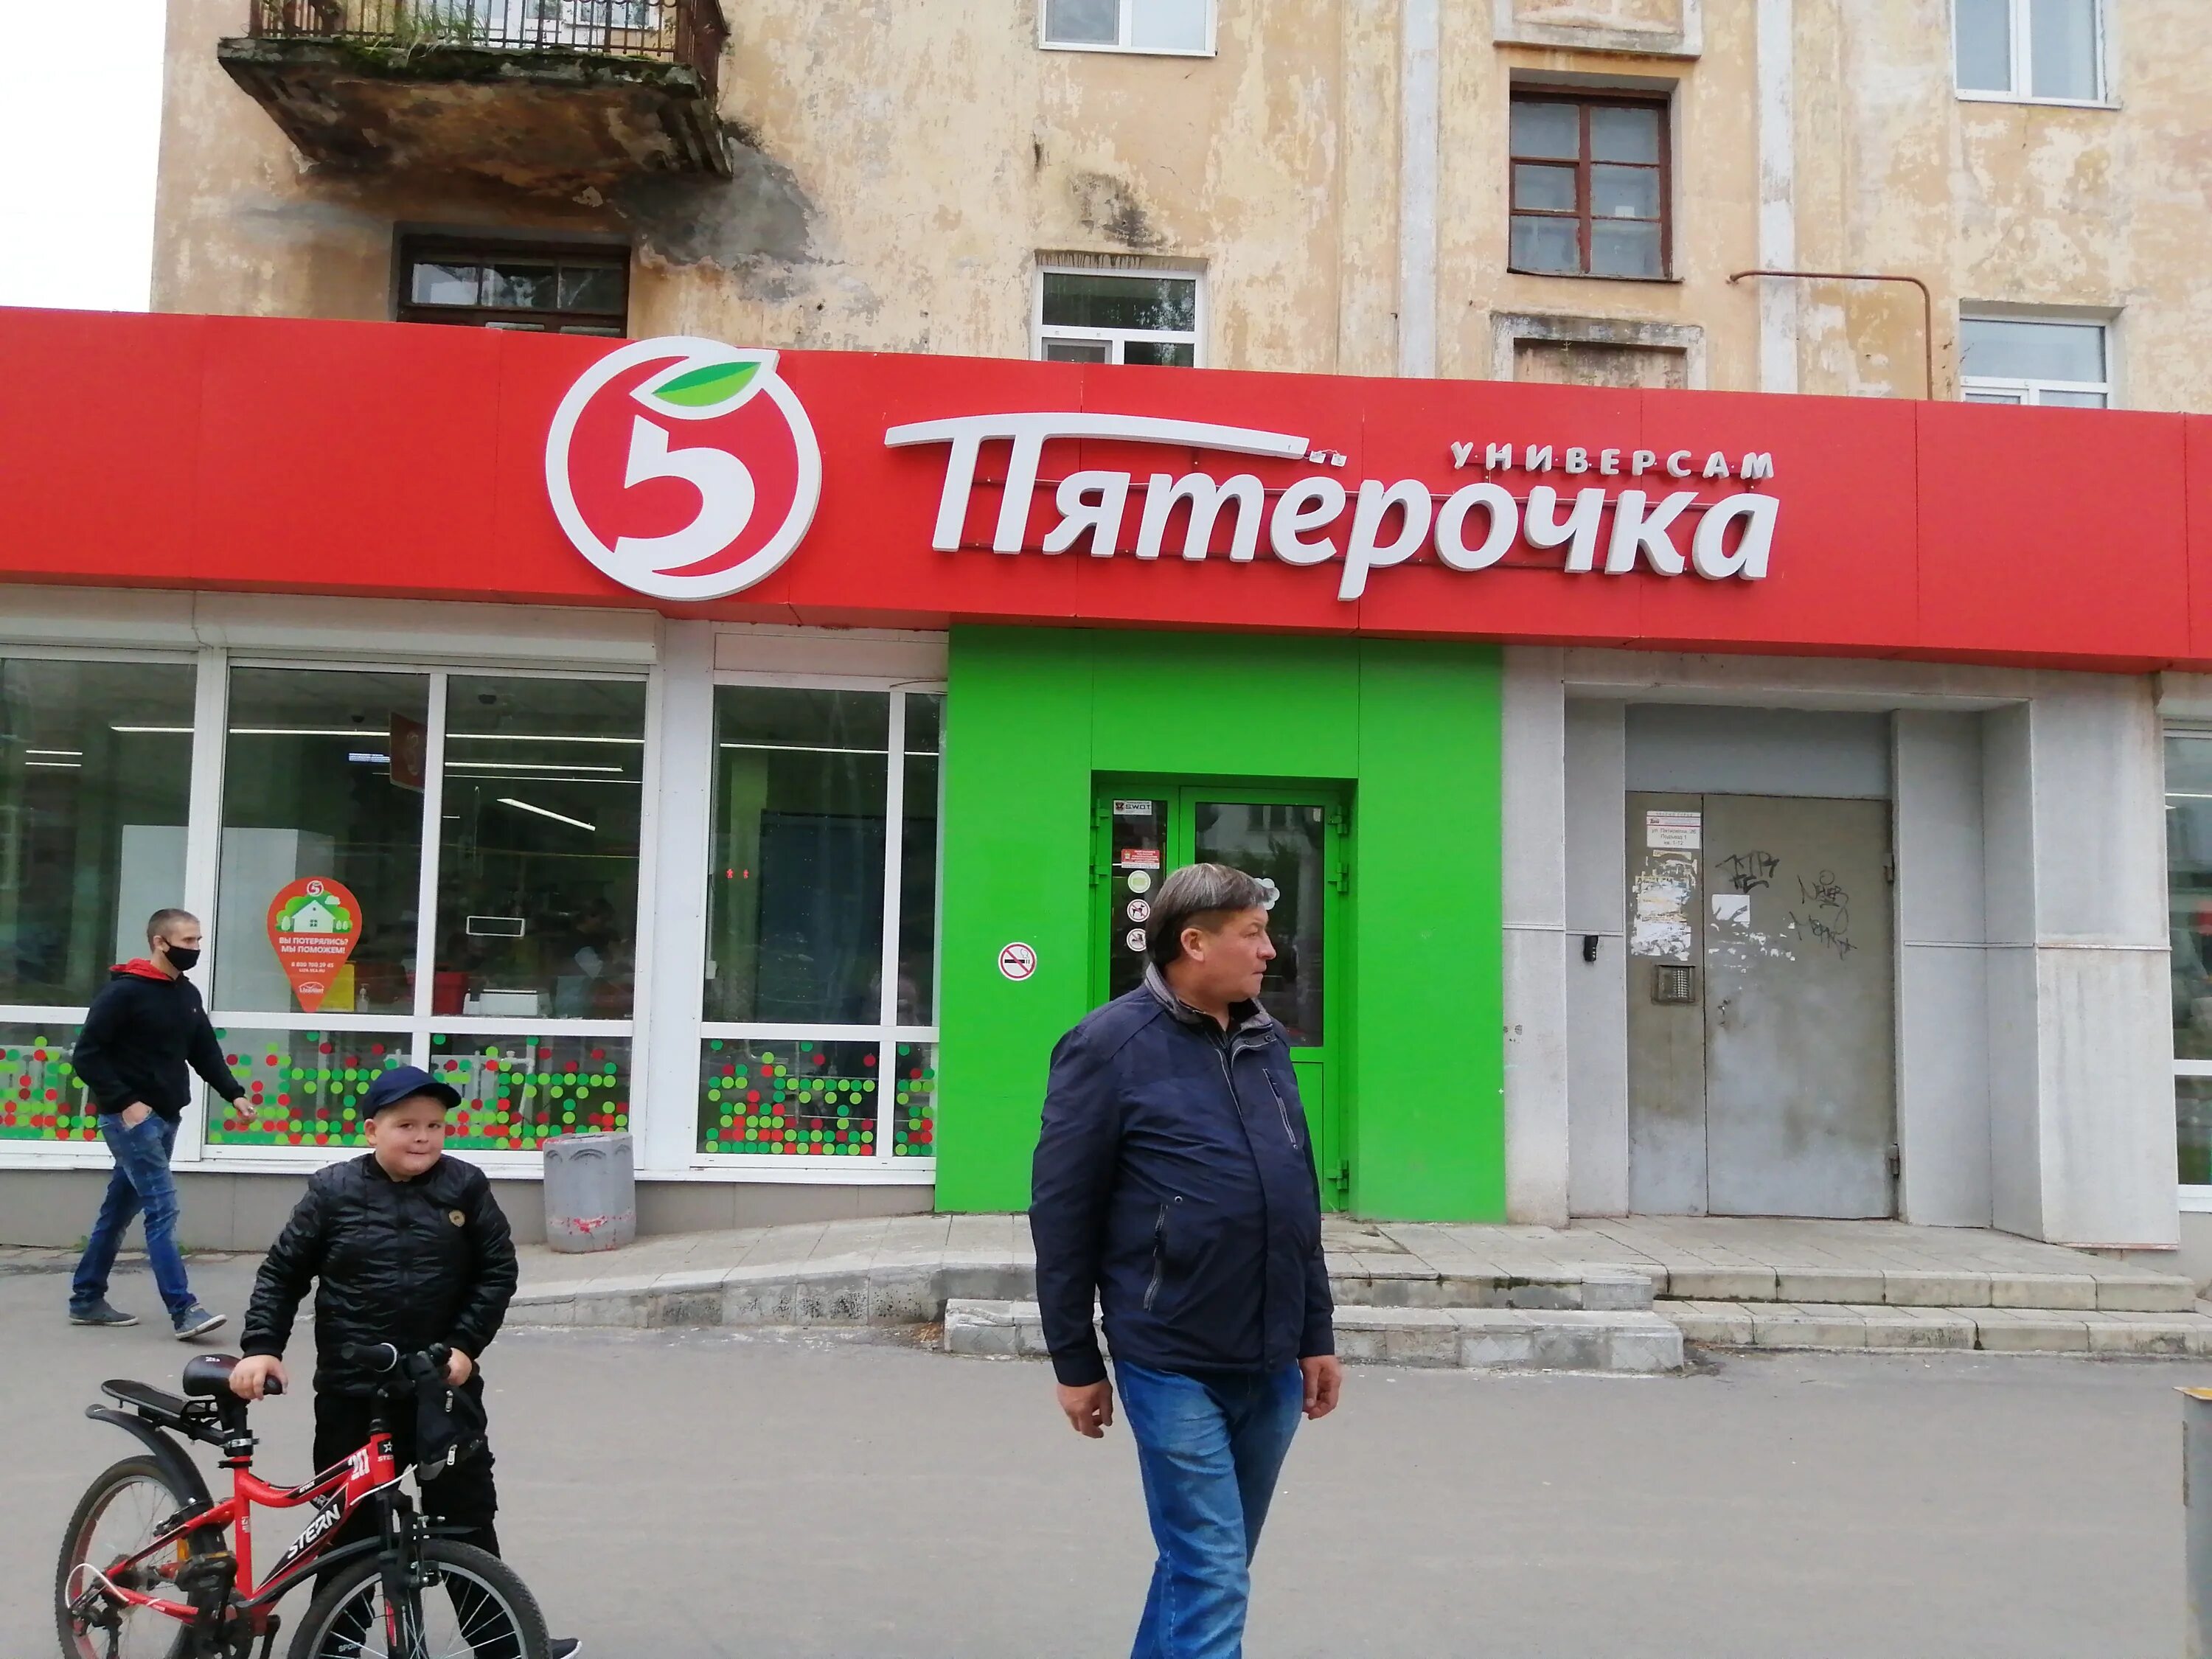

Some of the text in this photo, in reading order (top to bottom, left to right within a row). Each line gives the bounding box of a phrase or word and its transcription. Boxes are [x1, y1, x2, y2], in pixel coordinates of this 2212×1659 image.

[1450, 442, 1775, 480] УНИВЕРСАМ
[885, 411, 1781, 602] Пятёрочка
[293, 937, 349, 945] ПОТЕРЯЛИСЬ?
[287, 1503, 341, 1559] STERN
